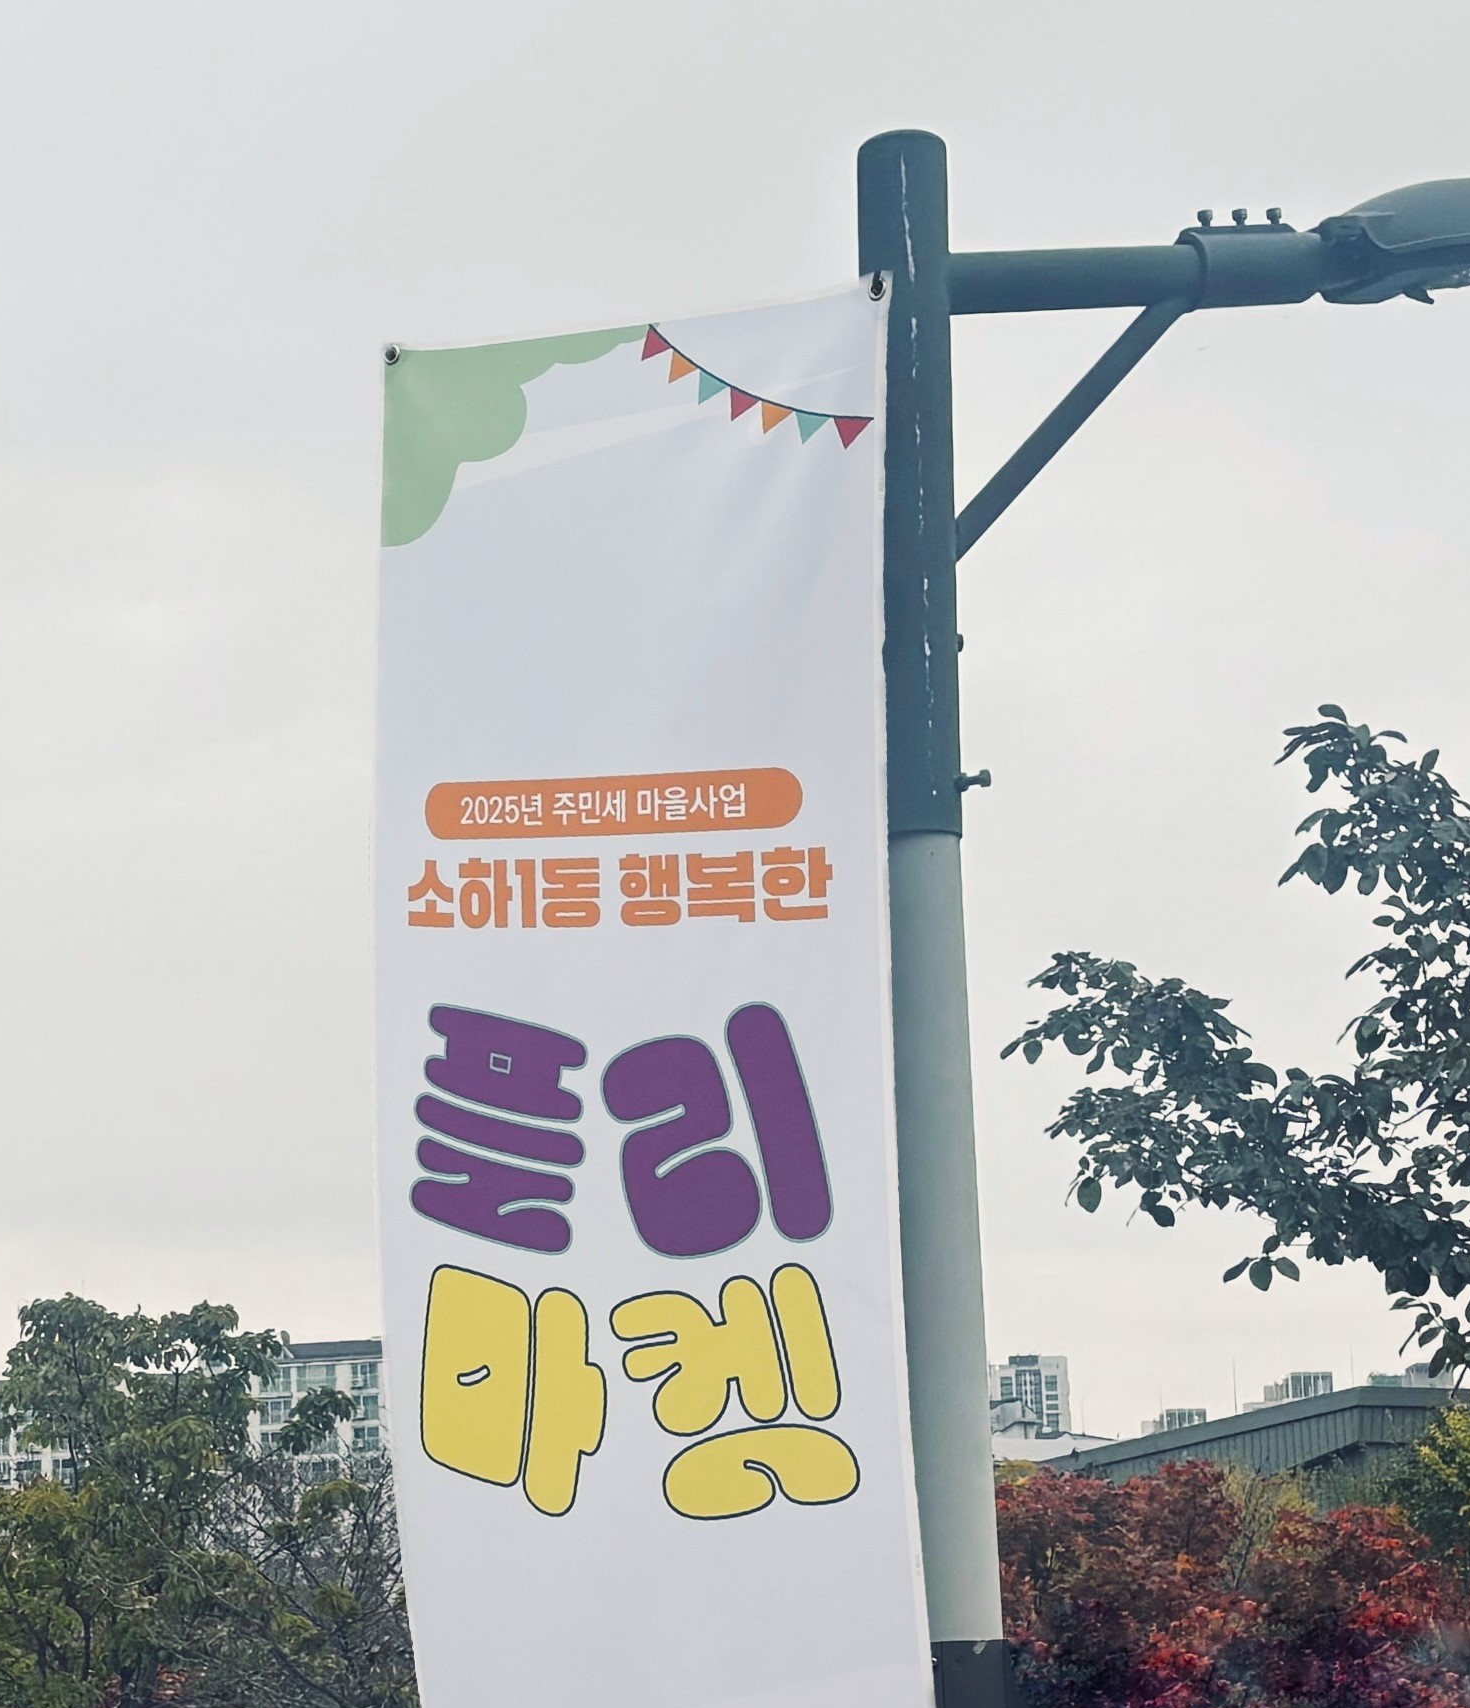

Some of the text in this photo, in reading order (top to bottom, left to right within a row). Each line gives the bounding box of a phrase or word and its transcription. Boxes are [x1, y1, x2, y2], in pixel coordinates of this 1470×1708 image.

[460, 783, 747, 827] 2025년 주민세 마을사업
[407, 846, 834, 930] 소하1동 행복한
[420, 1262, 861, 1520] 마켓
